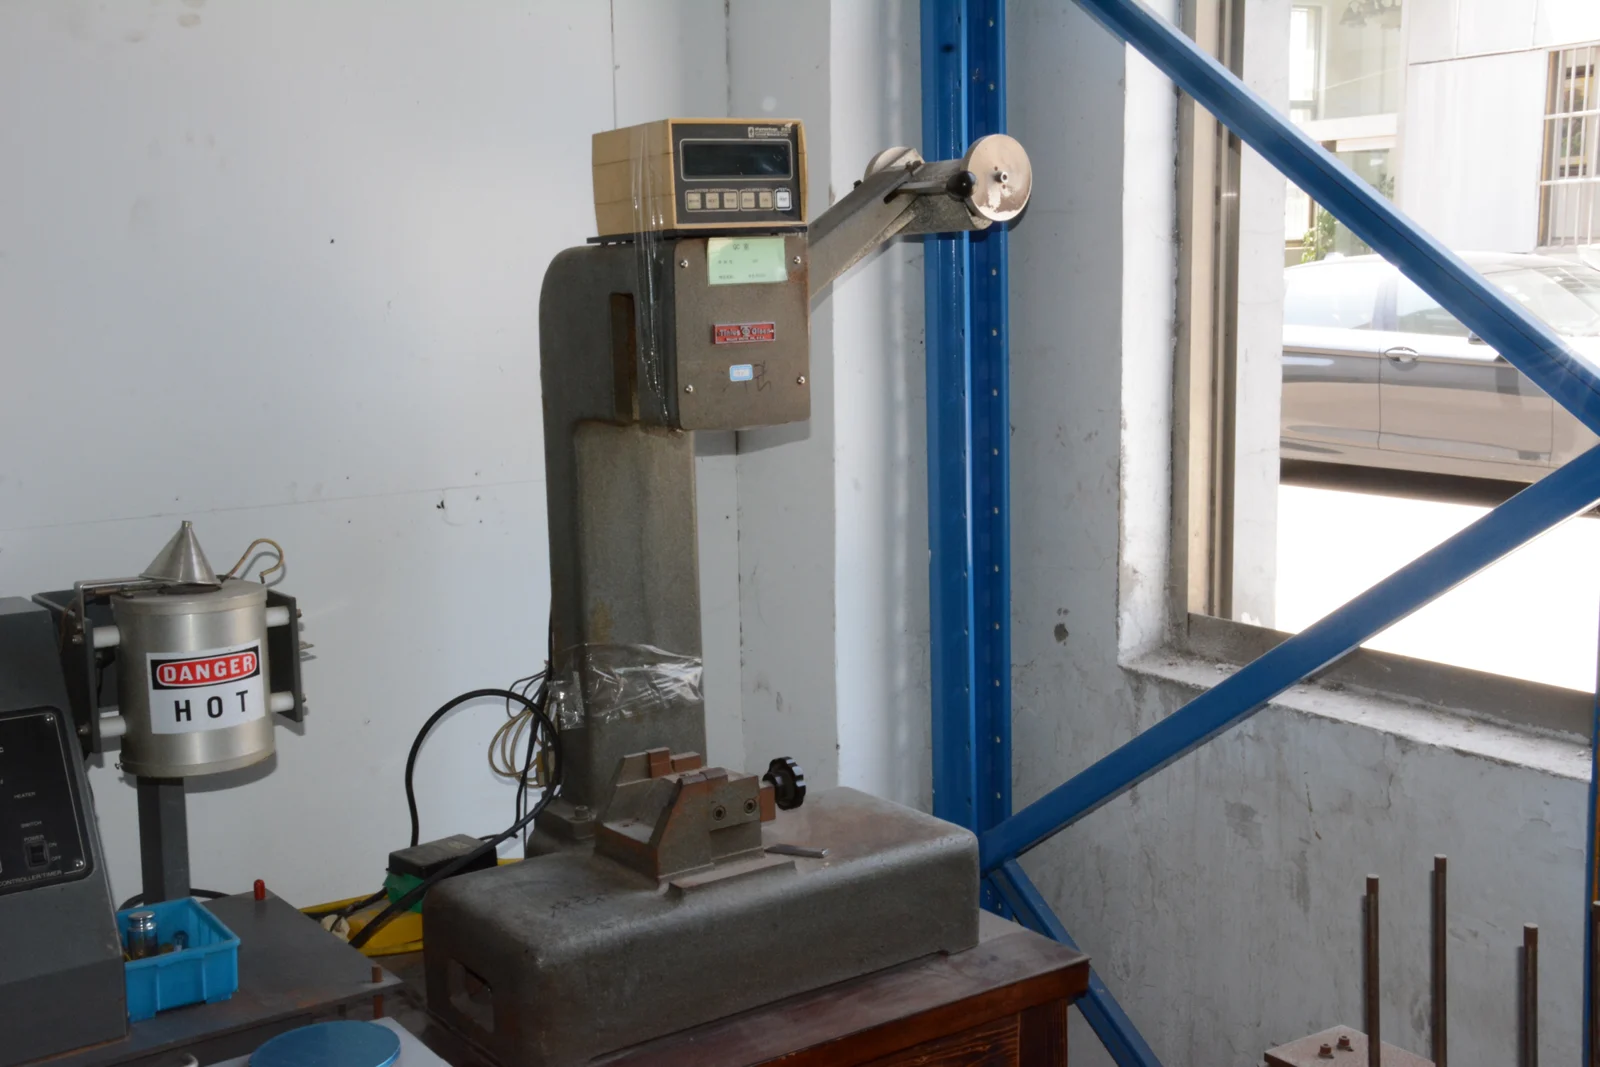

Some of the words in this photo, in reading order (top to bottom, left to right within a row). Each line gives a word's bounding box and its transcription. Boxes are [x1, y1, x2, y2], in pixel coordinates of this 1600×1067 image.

[163, 655, 253, 682] DANGER
[174, 690, 249, 722] HOT
[23, 834, 45, 842] POWER
